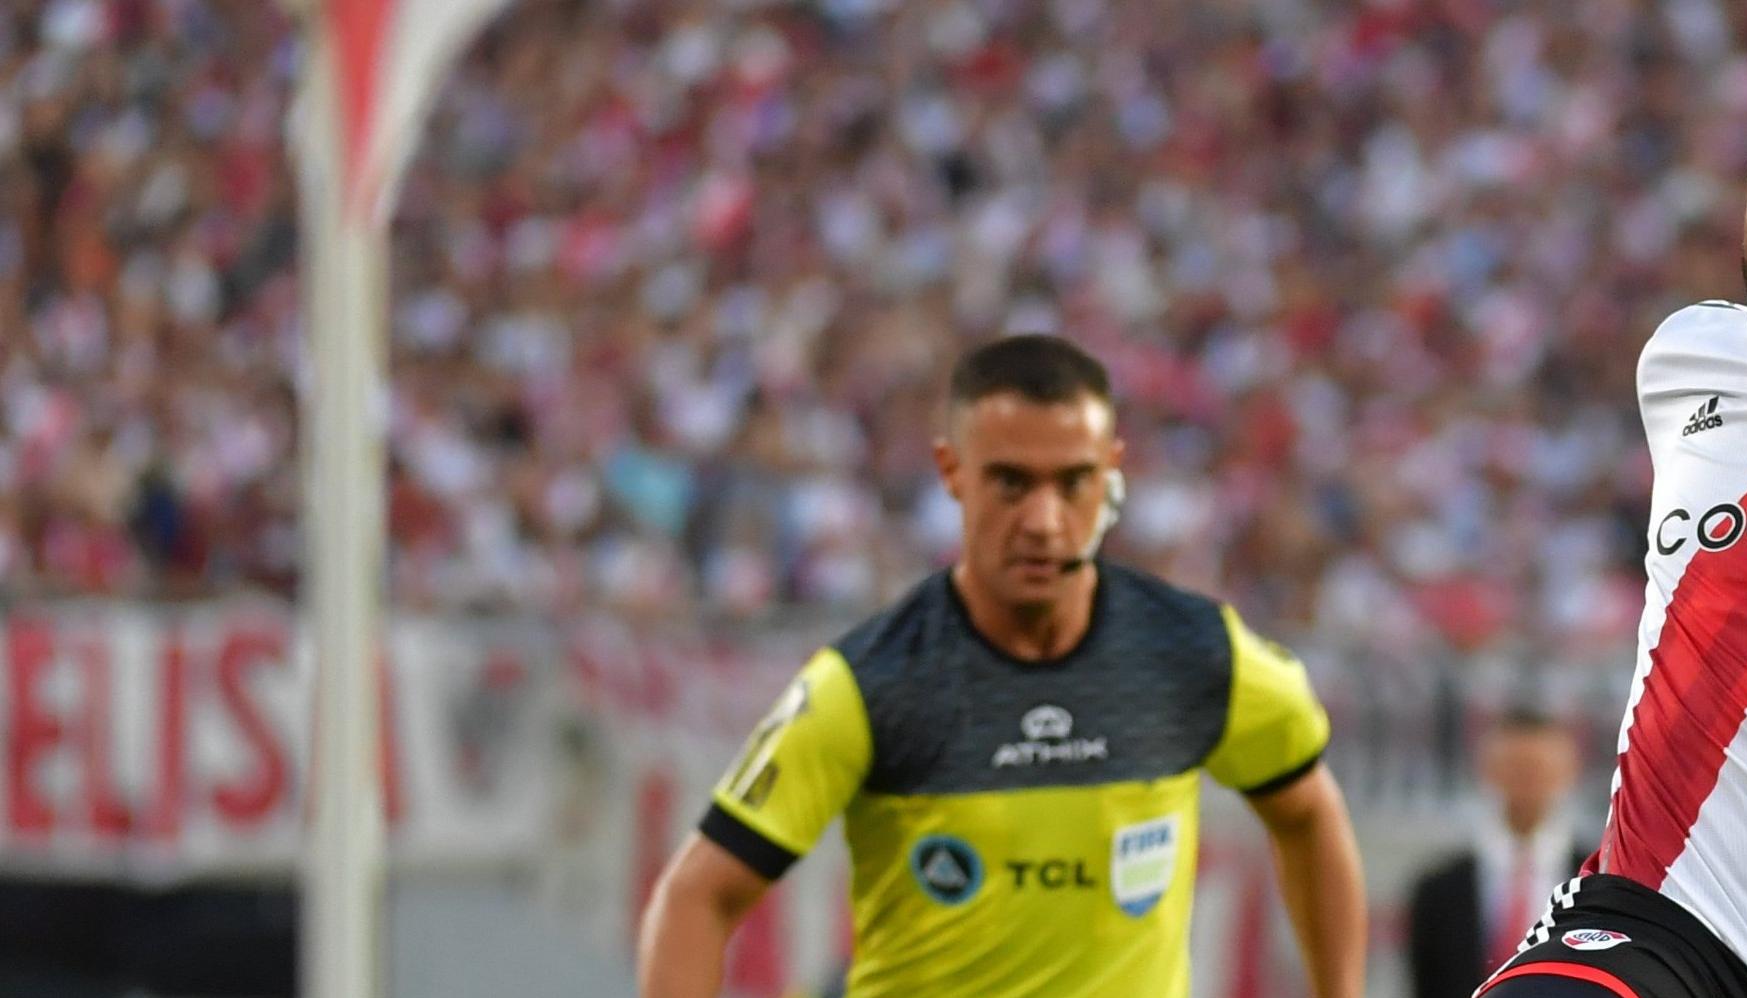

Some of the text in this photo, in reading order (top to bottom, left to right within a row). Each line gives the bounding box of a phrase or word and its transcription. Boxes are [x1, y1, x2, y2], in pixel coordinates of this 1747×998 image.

[1682, 413, 1723, 437] adidas
[1121, 824, 1171, 856] FIFA
[1006, 859, 1095, 888] TCL
